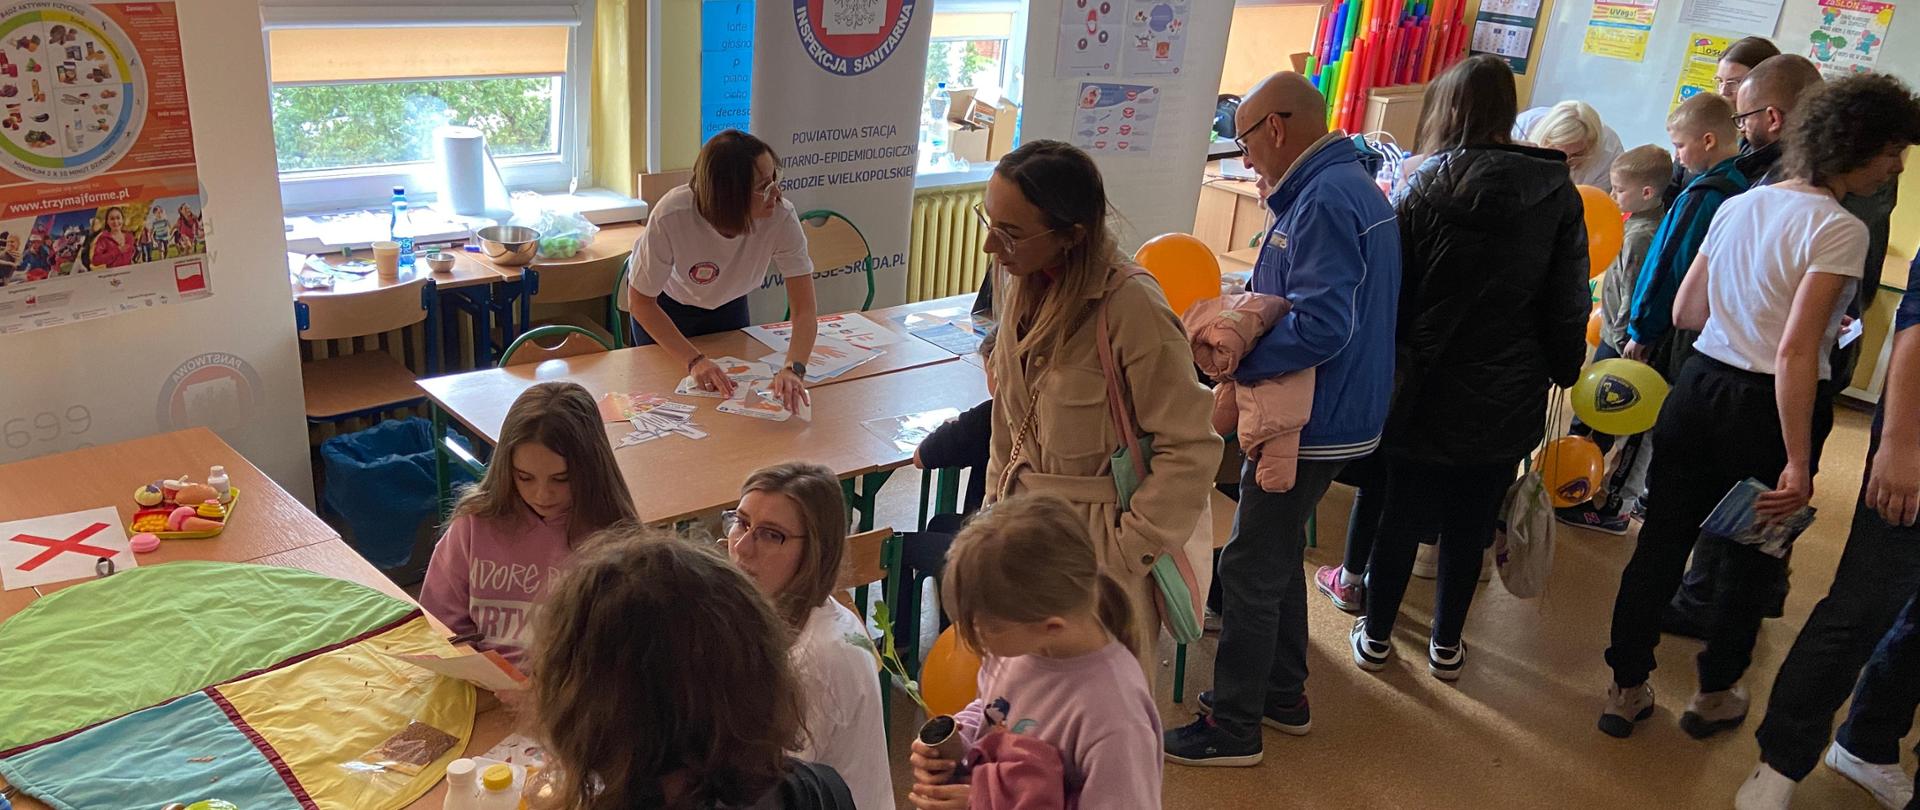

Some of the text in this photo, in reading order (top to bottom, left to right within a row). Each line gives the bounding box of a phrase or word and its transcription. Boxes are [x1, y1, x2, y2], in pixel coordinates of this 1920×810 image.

[726, 22, 748, 32] forte
[796, 4, 913, 73] INSPEKCJA SANITARNA
[792, 125, 897, 145] POWIATOWA STACJA
[779, 164, 914, 192] ŚRODZIE WIELKOPOLSKIEJ
[9, 188, 130, 214] www.trzymajforme.pl
